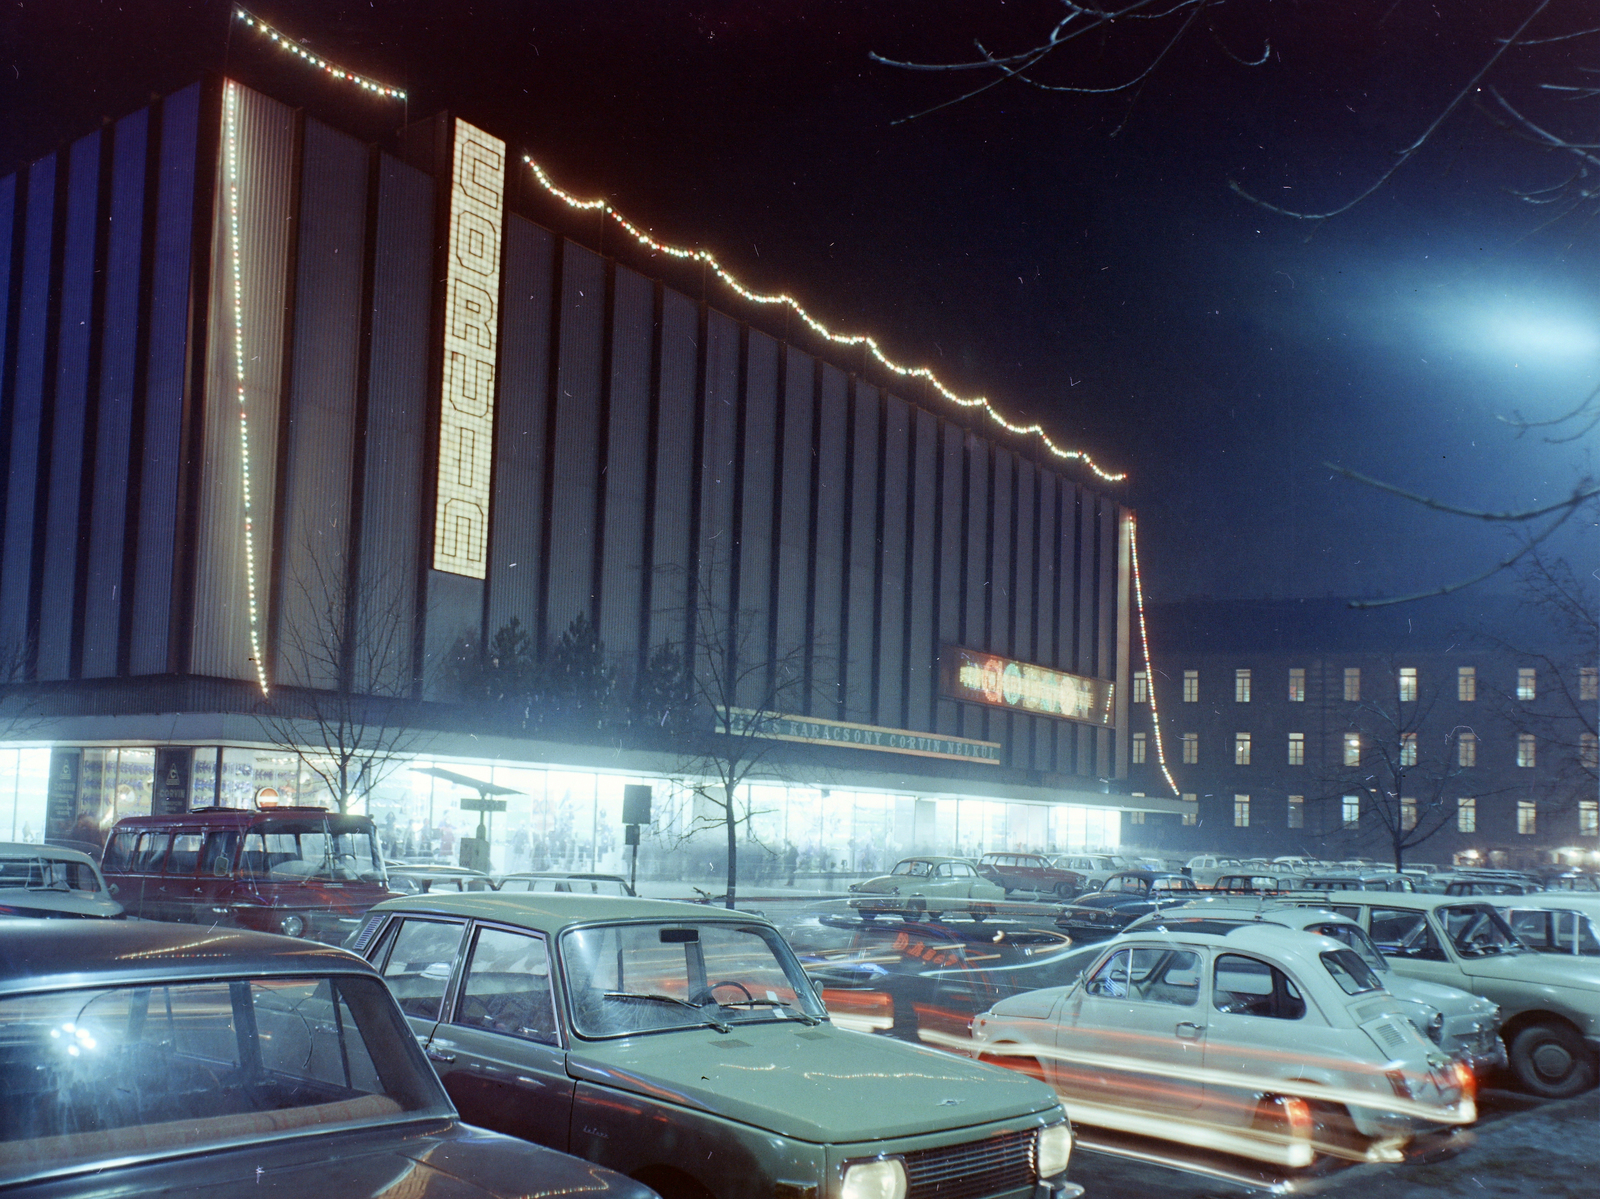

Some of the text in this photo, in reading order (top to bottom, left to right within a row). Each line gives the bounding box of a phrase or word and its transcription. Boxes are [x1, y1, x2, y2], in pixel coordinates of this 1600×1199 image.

[442, 138, 500, 563] CORVIN
[789, 721, 883, 746] KARÁCSONY
[889, 734, 941, 753] CORVIN
